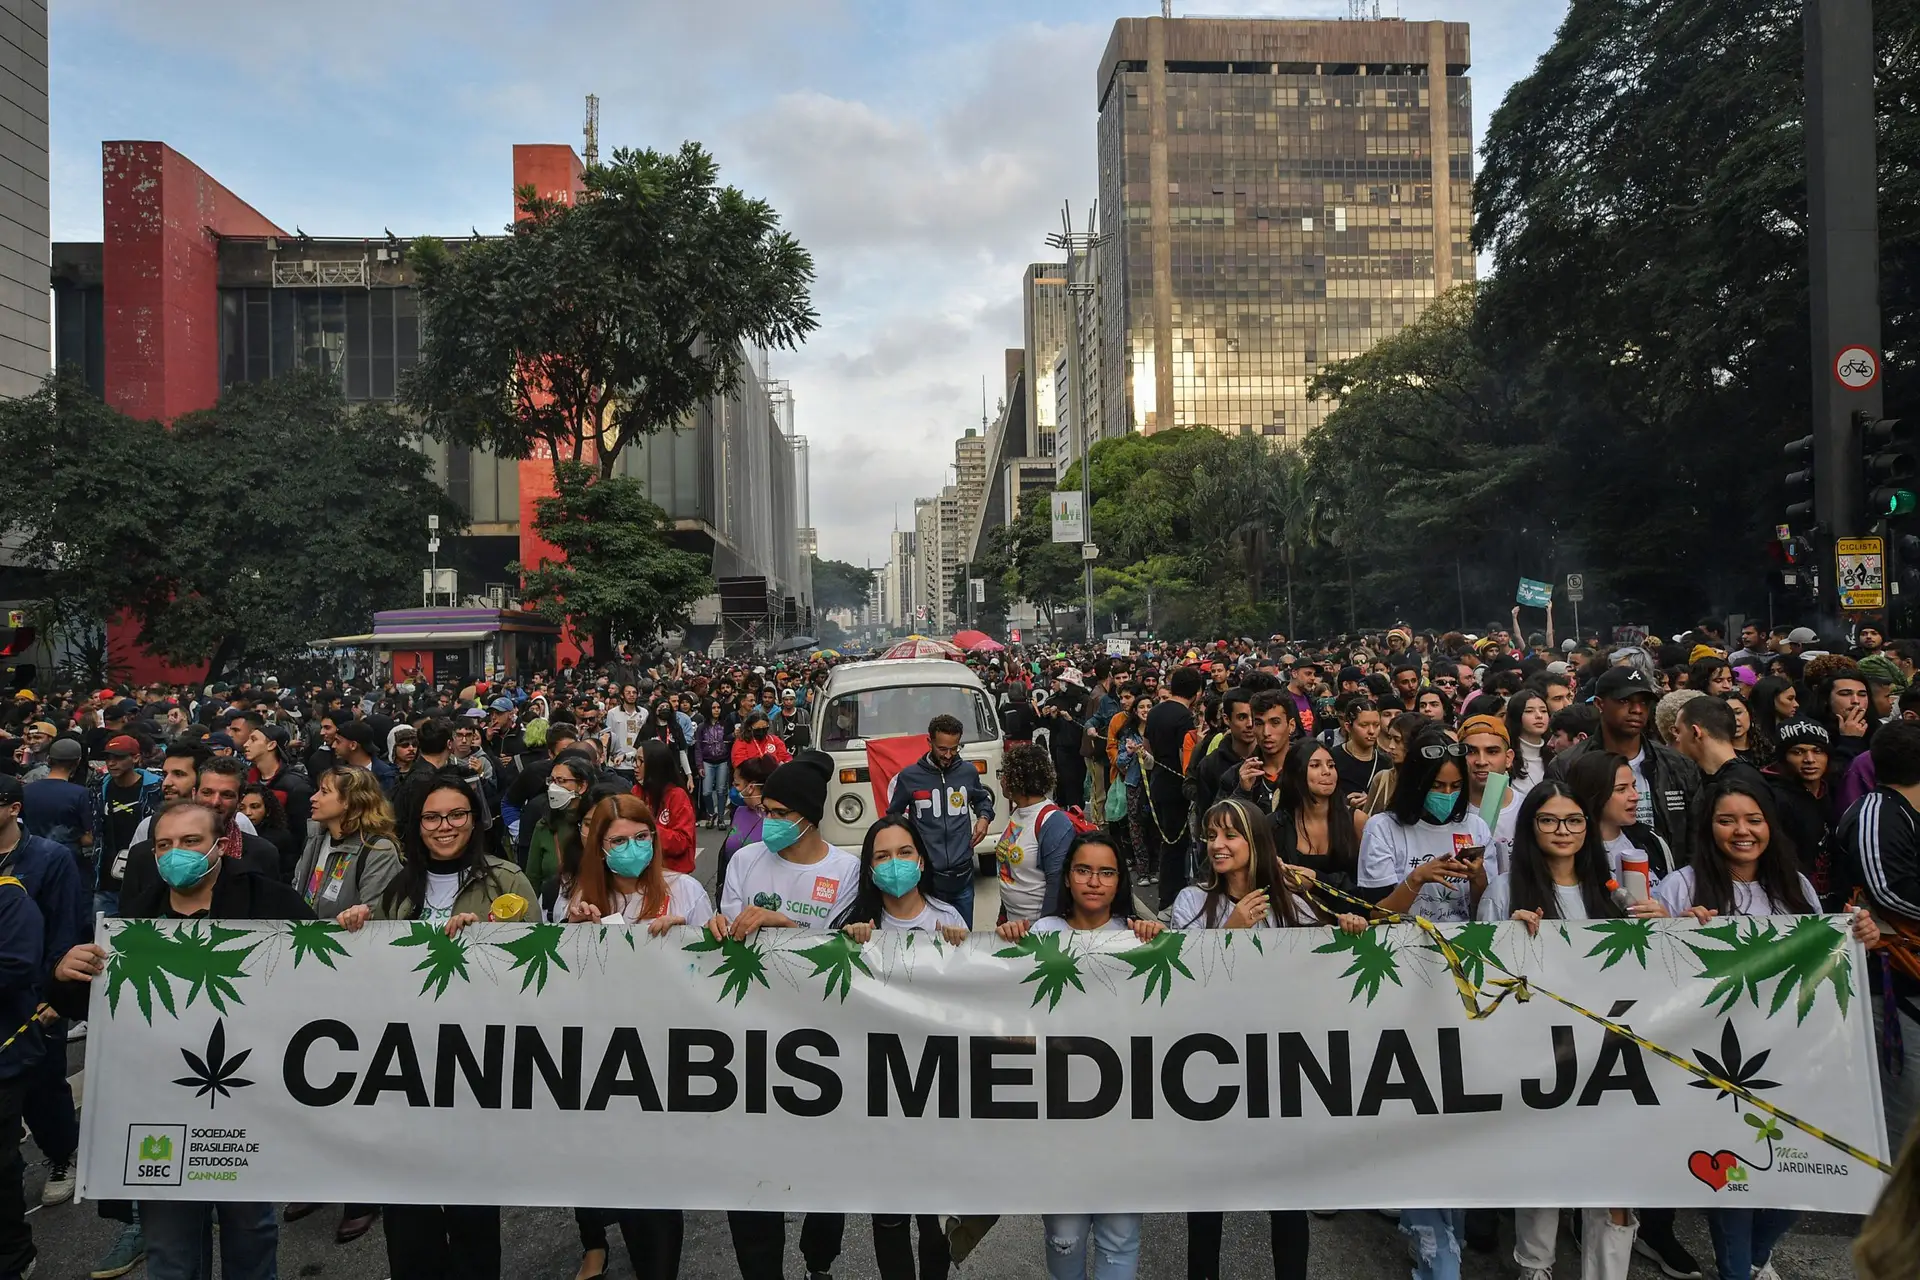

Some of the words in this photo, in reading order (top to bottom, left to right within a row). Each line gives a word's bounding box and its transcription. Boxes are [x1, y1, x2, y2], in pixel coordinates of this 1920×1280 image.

[1840, 543, 1878, 551] CICLISTA
[282, 1018, 843, 1118] CANNABIS
[866, 1027, 1503, 1121] MEDICINAL
[1520, 1000, 1661, 1109] JÁ
[190, 1128, 247, 1139] SOCIEDADE
[189, 1142, 245, 1153] BRASILEIRA
[246, 1143, 260, 1153] DE
[1774, 1146, 1809, 1160] Mães
[188, 1156, 233, 1167] ESTUDOS
[234, 1157, 249, 1167] DA
[137, 1164, 171, 1178] SBEC
[1777, 1162, 1849, 1176] JARDINEIRAS
[187, 1171, 238, 1182] CANNABIS
[1727, 1183, 1749, 1192] SBEC
